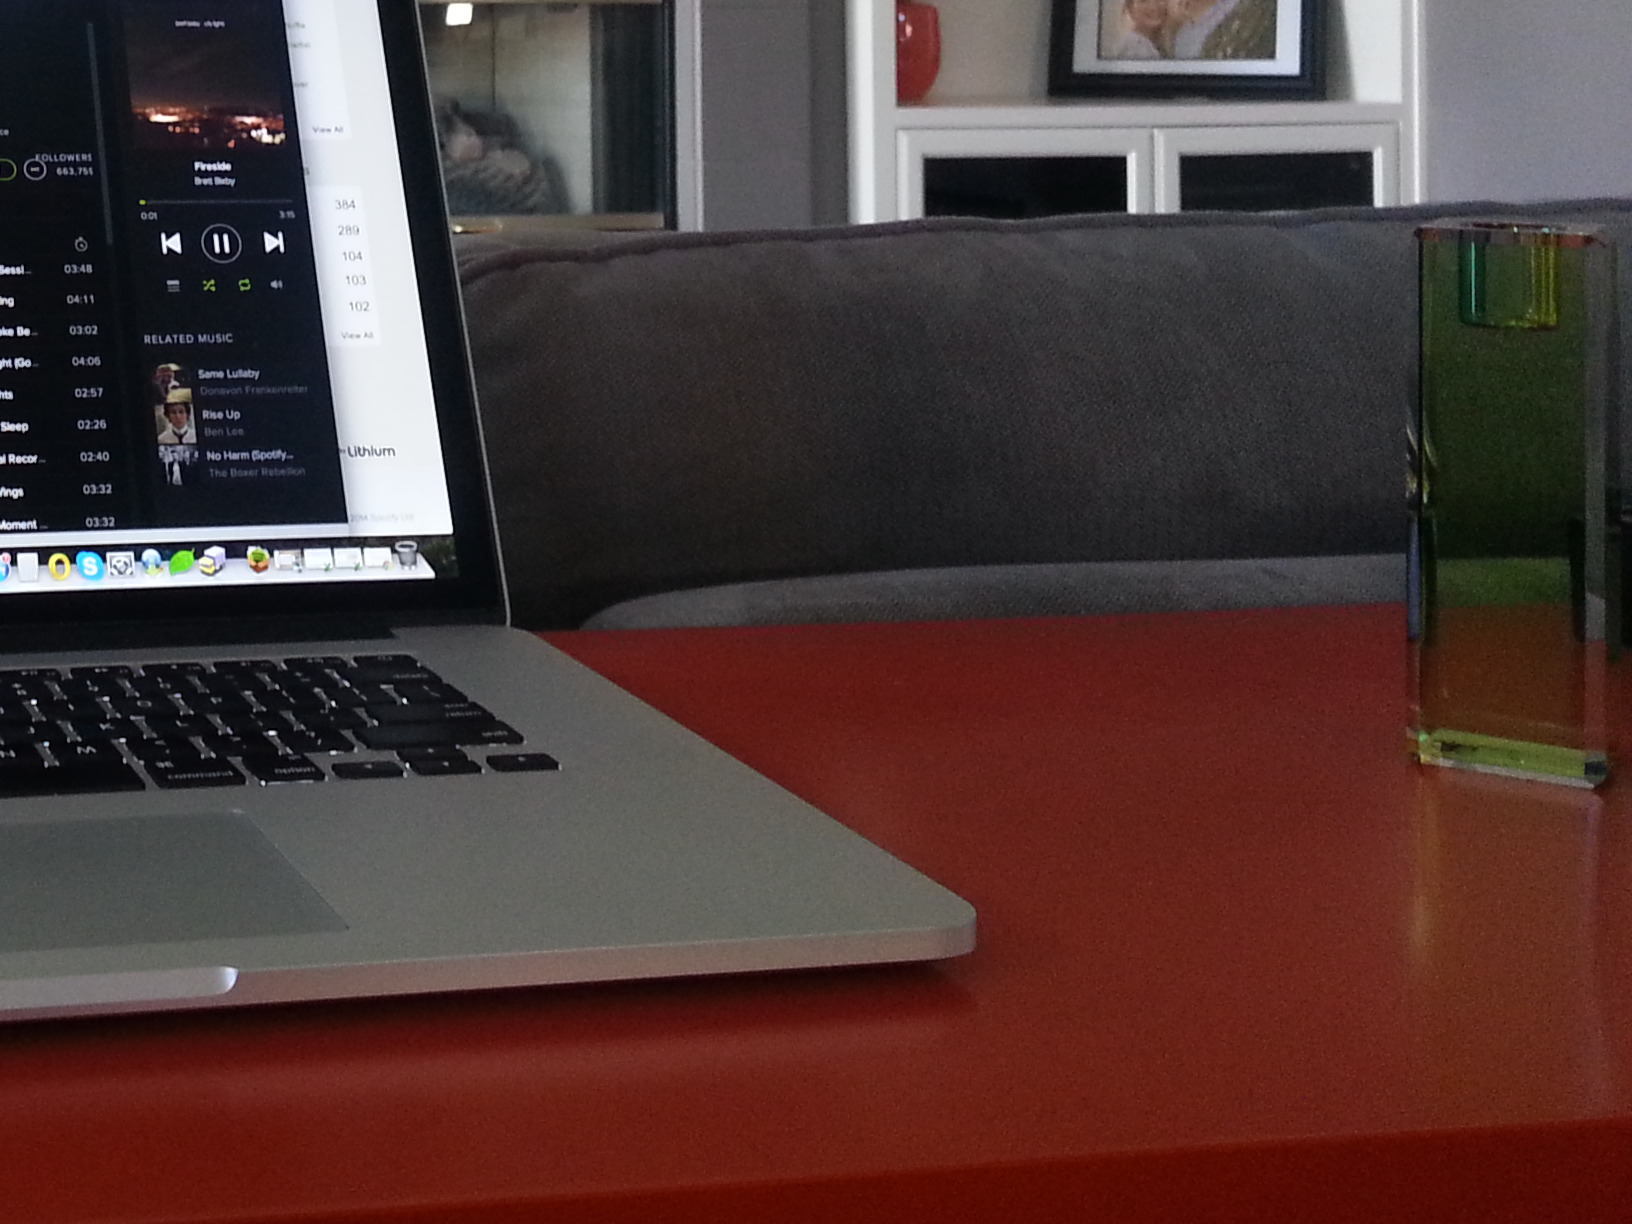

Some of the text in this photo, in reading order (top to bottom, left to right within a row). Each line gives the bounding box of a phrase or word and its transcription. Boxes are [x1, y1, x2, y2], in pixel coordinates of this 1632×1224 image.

[194, 161, 232, 171] Fireside
[335, 199, 356, 210] 384
[140, 211, 158, 220] 0:01
[279, 210, 296, 219] 3:15
[338, 225, 360, 236] 289
[342, 251, 363, 261] 104
[64, 264, 93, 274] 03:48
[346, 275, 367, 286] 103
[66, 294, 94, 304] 04:11
[349, 301, 370, 312] 102
[69, 325, 98, 335] 03:02
[144, 333, 233, 344] RELATED MUSIC
[72, 356, 101, 366] 04:06
[74, 387, 103, 398] 02:57
[202, 409, 241, 420] Rise Up
[0, 421, 29, 433] Sleep
[77, 419, 107, 430] 02:26
[80, 451, 110, 462] 02:40
[206, 450, 250, 461] No Harm
[347, 445, 396, 458] Lithium
[83, 484, 112, 495] 03:32
[85, 516, 115, 528] 03:32
